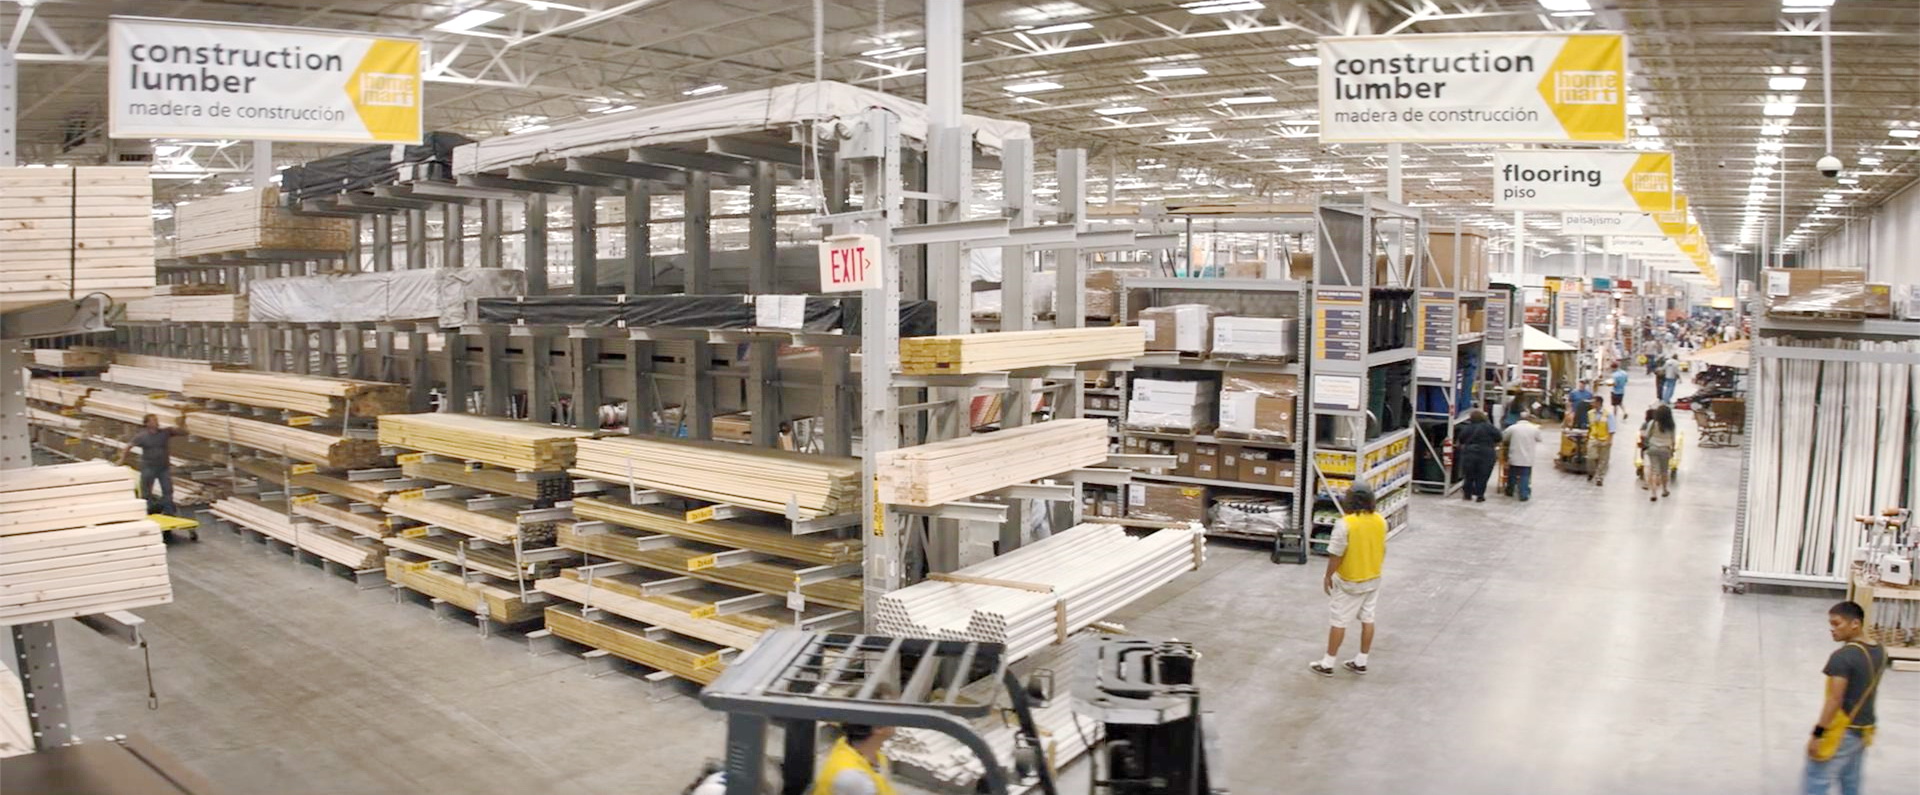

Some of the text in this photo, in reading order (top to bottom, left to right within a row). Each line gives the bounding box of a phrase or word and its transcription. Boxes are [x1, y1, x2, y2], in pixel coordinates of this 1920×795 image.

[130, 42, 343, 72] construction
[1334, 50, 1534, 75] construction
[131, 64, 256, 93] lumber
[1335, 77, 1446, 100] lumber
[1558, 71, 1617, 88] home
[1558, 88, 1617, 104] mart
[129, 100, 345, 121] madera de construcción
[1334, 106, 1539, 123] madera de construcción
[1502, 164, 1601, 187] flooring
[1504, 186, 1536, 200] piso
[1566, 214, 1621, 226] paisajismo
[831, 247, 865, 283] EXIT
